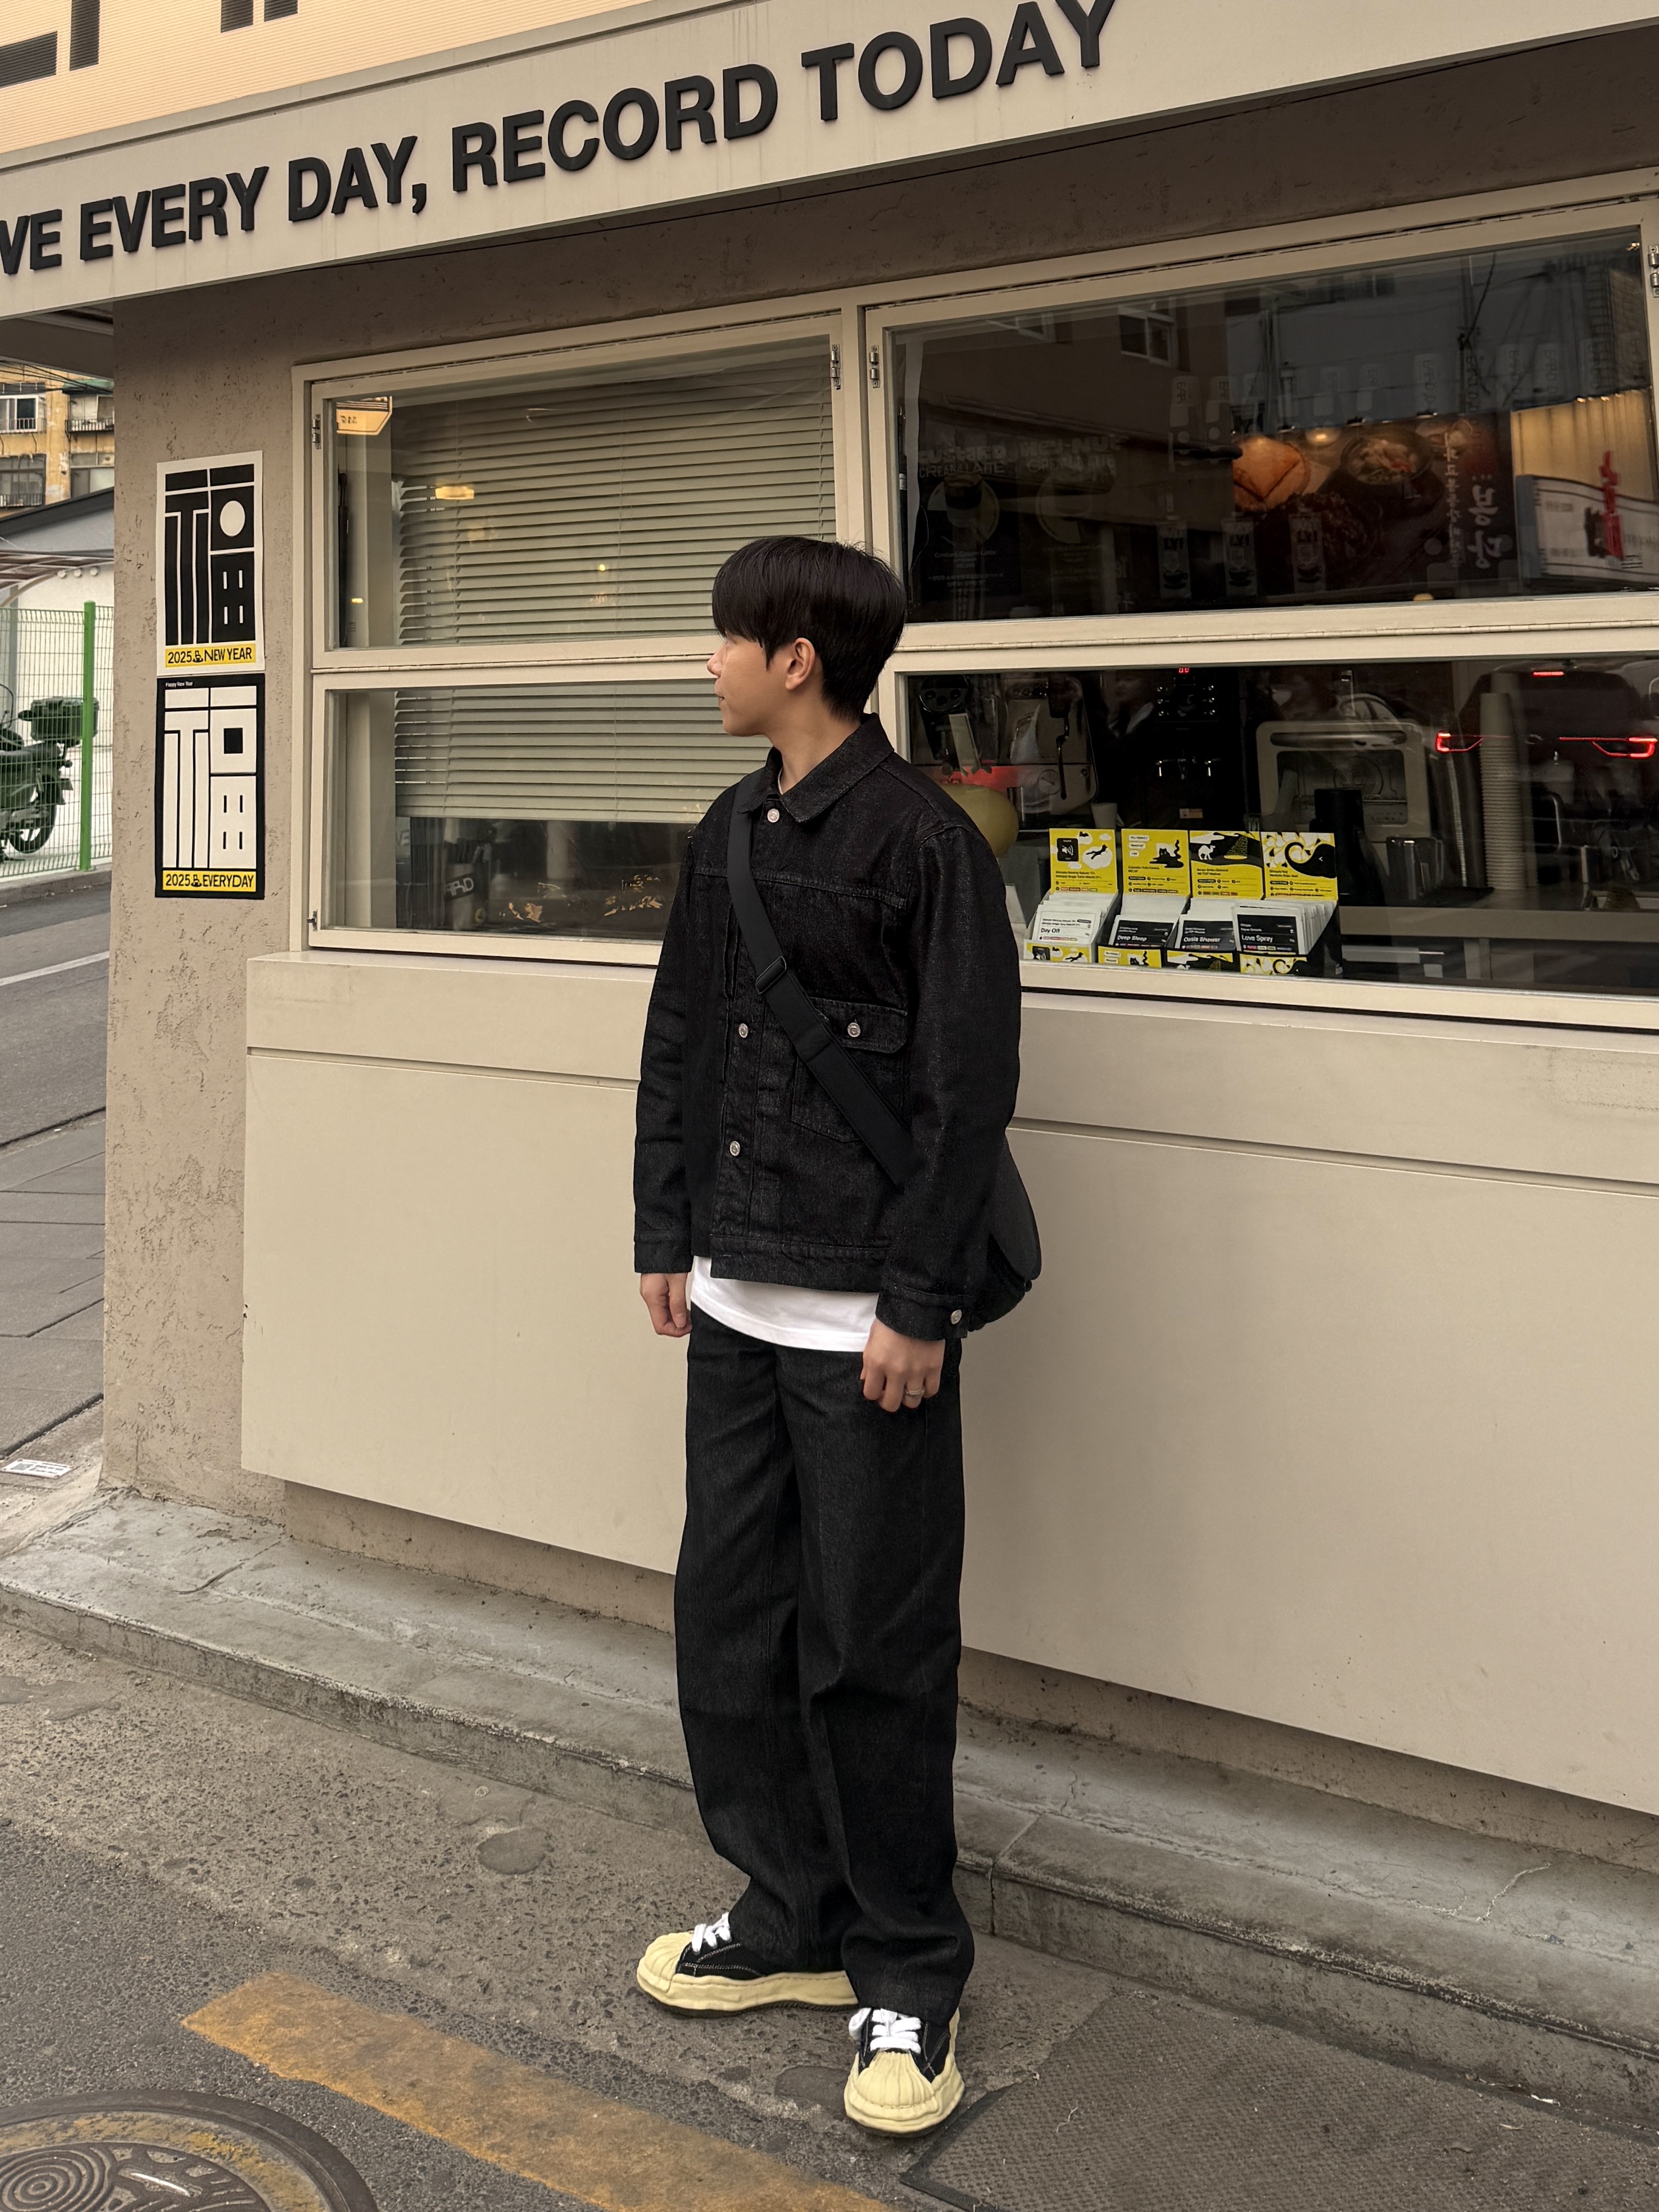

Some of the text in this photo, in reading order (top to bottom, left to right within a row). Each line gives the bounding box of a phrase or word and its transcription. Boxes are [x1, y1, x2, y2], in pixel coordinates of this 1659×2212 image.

[80, 166, 269, 261] EVERY
[288, 135, 427, 222] DAY,
[452, 63, 778, 192] RECORD
[801, 0, 1116, 121] TODAY
[168, 647, 252, 664] 2025 NEW YEAR
[166, 874, 254, 888] 2025 EVERYDAY
[1255, 934, 1273, 943] Spray
